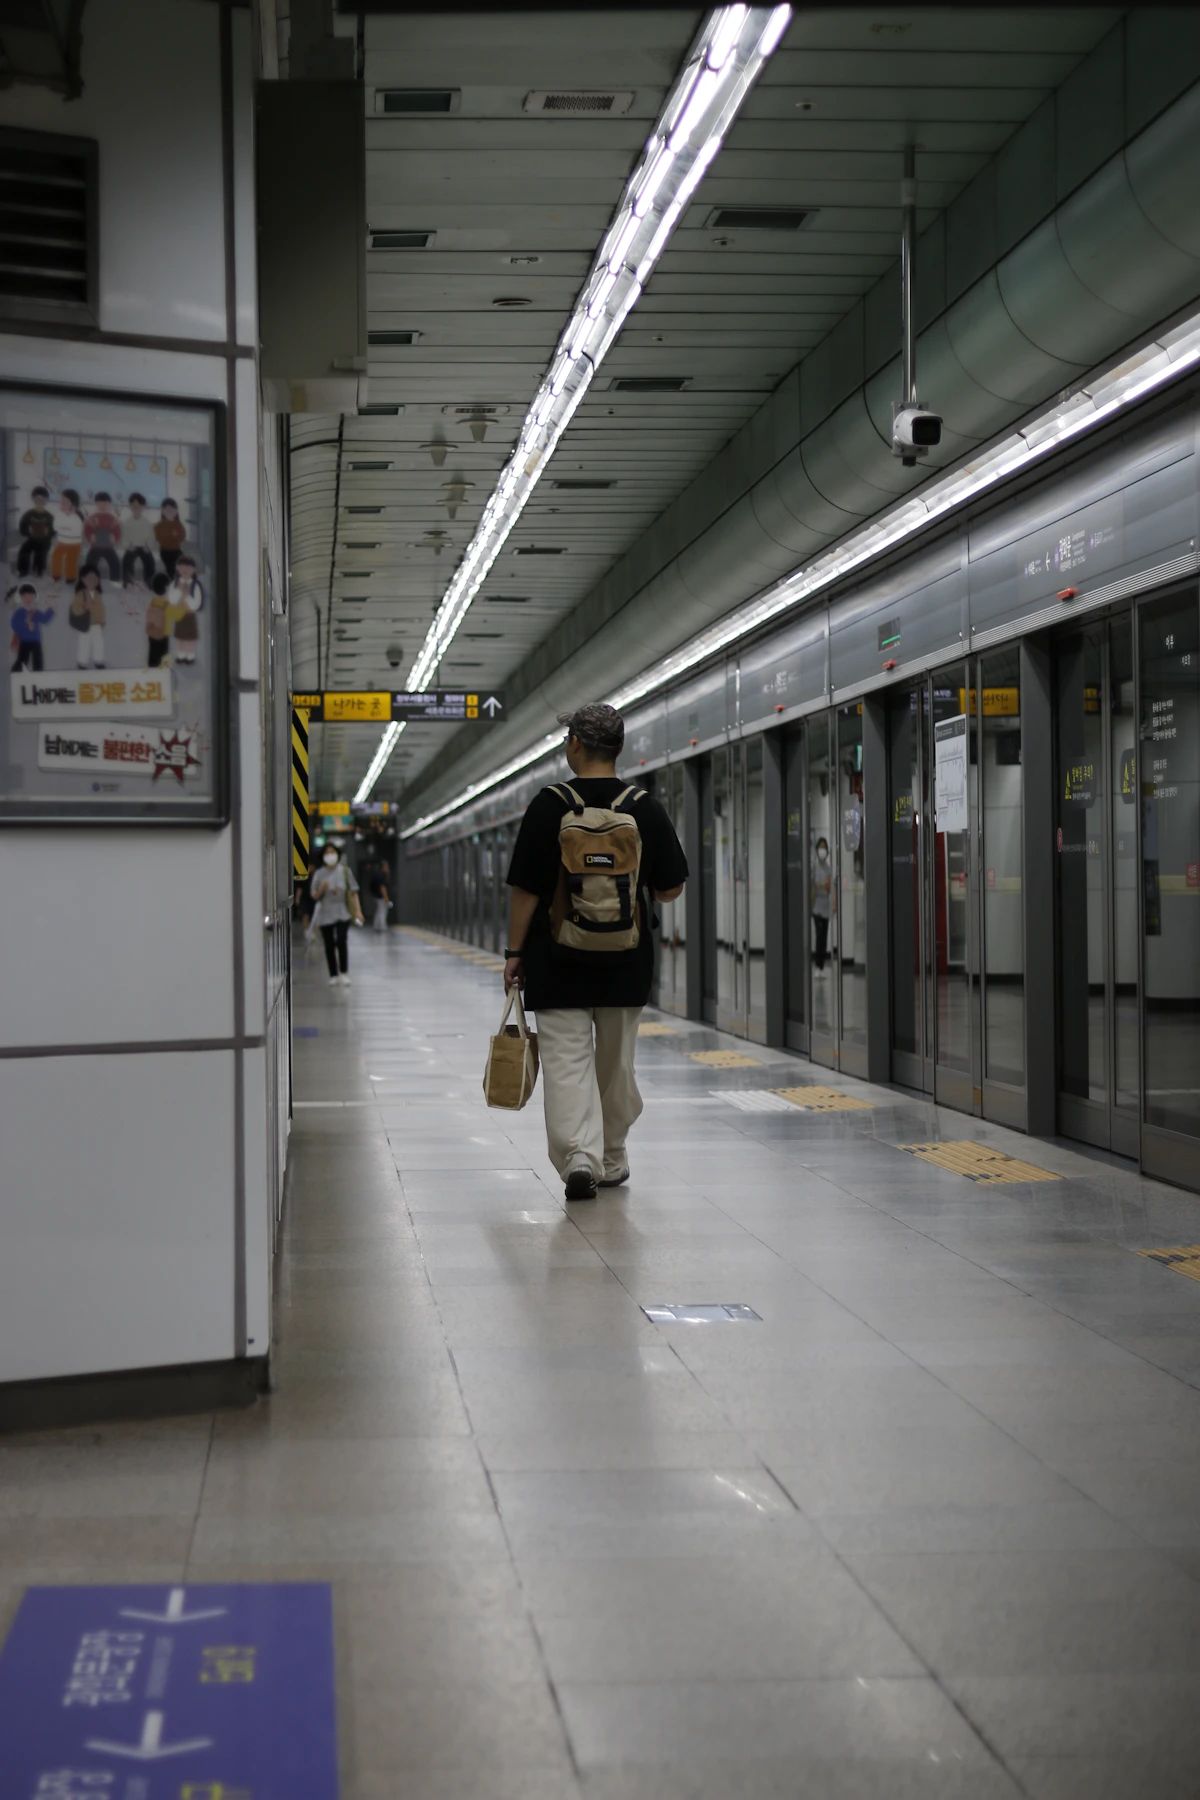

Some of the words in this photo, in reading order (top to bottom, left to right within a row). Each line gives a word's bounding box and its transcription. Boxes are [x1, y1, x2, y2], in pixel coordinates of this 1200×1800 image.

[20, 684, 76, 705] 나에게는
[78, 682, 127, 704] 즐거운
[333, 697, 366, 710] 나가는
[370, 697, 381, 710] 곳
[44, 734, 99, 758] 남에게는
[103, 738, 152, 763] 불편한
[154, 742, 188, 766] 소음
